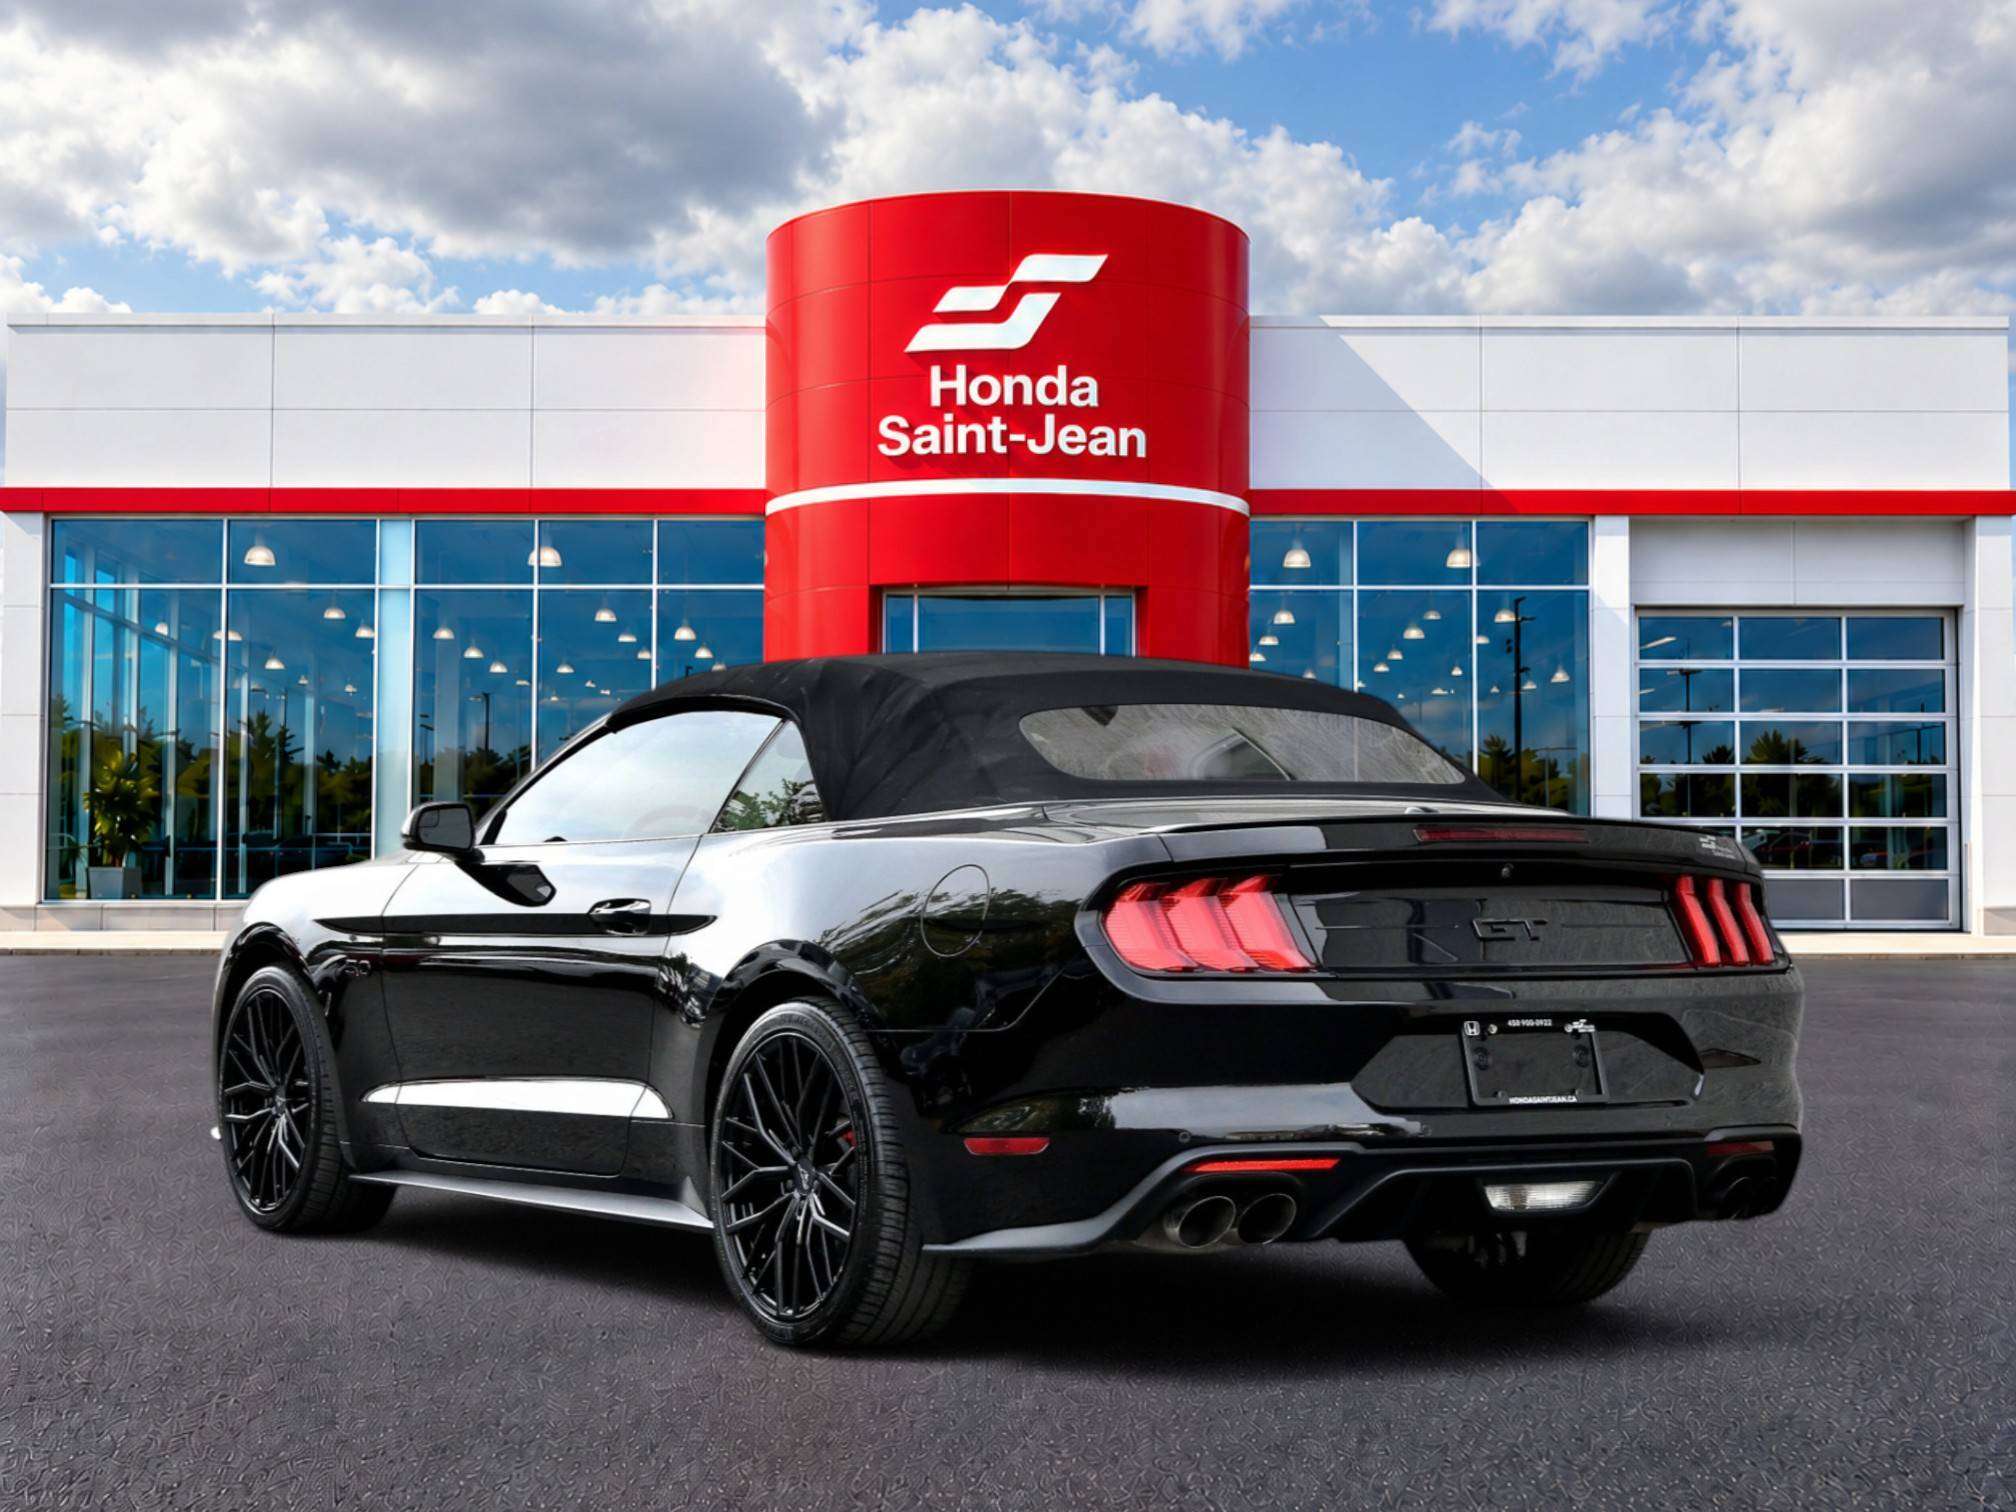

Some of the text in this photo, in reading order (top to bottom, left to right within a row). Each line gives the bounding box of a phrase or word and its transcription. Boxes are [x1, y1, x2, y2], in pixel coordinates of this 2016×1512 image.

[930, 364, 1099, 407] Honda
[877, 412, 1147, 458] Saint-Jean
[1472, 918, 1548, 942] GT
